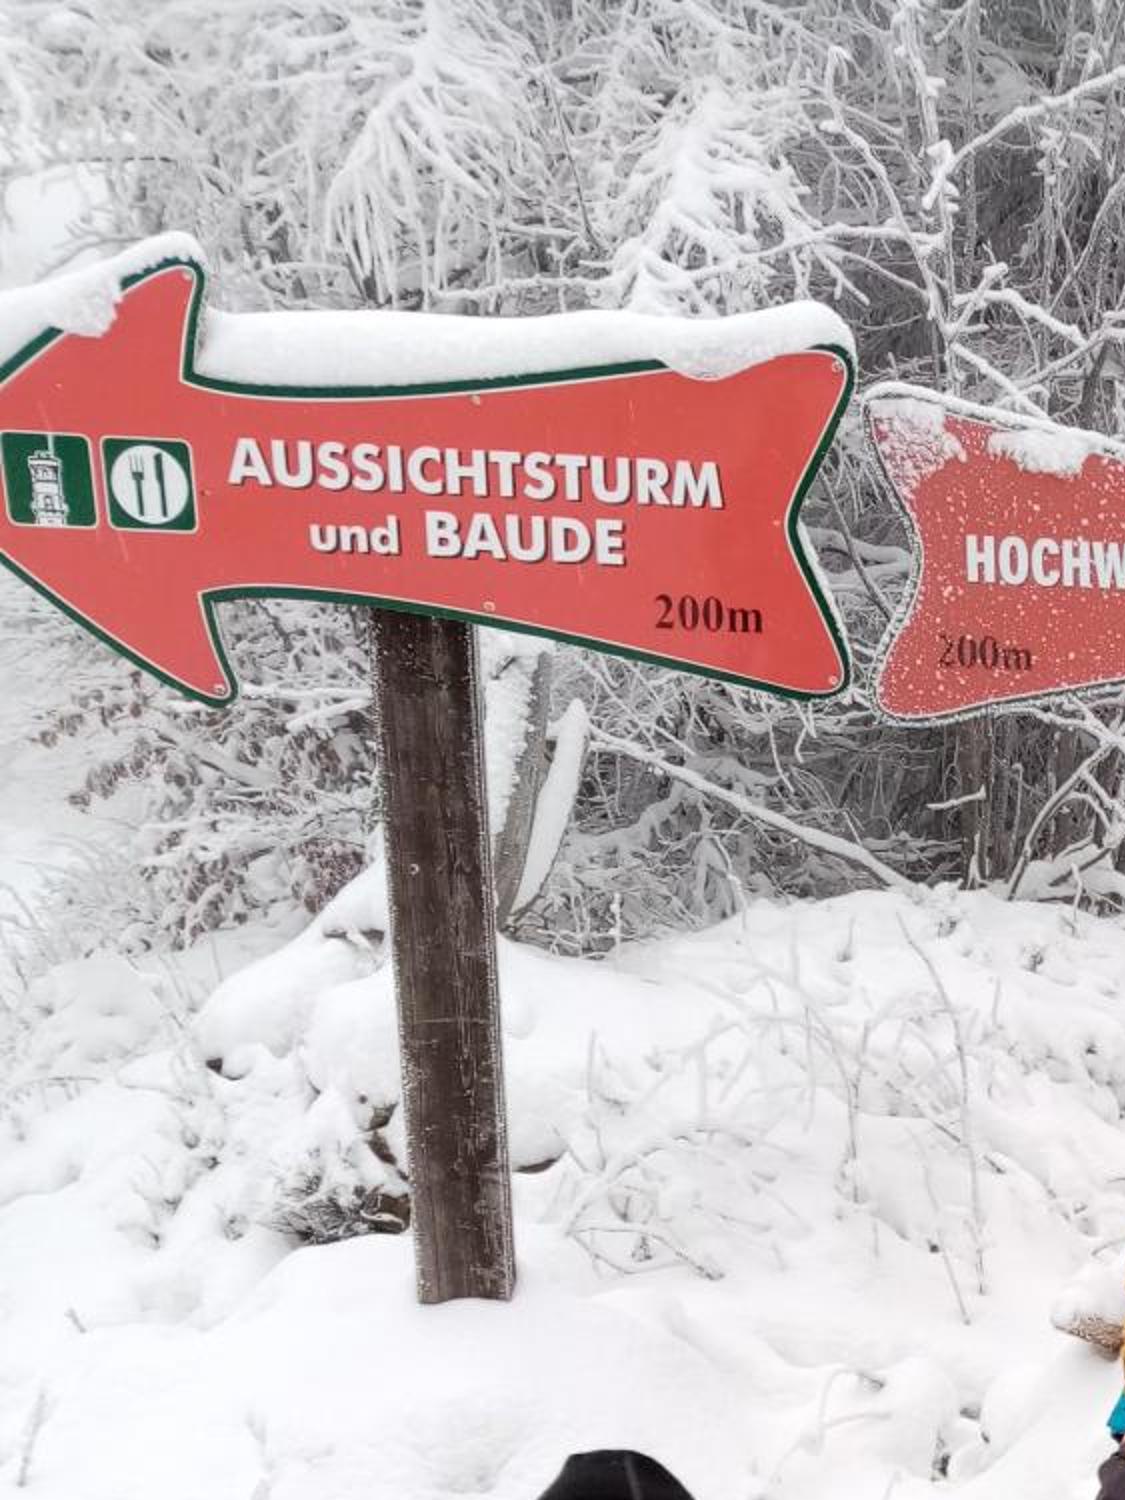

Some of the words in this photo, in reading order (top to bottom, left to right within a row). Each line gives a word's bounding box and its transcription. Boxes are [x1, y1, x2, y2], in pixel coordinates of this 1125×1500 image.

[228, 437, 724, 509] AUSSICHTSTURM
[309, 514, 401, 556] und
[425, 510, 626, 567] BAUDE
[654, 593, 764, 634] 200m
[938, 634, 1033, 672] 200m
